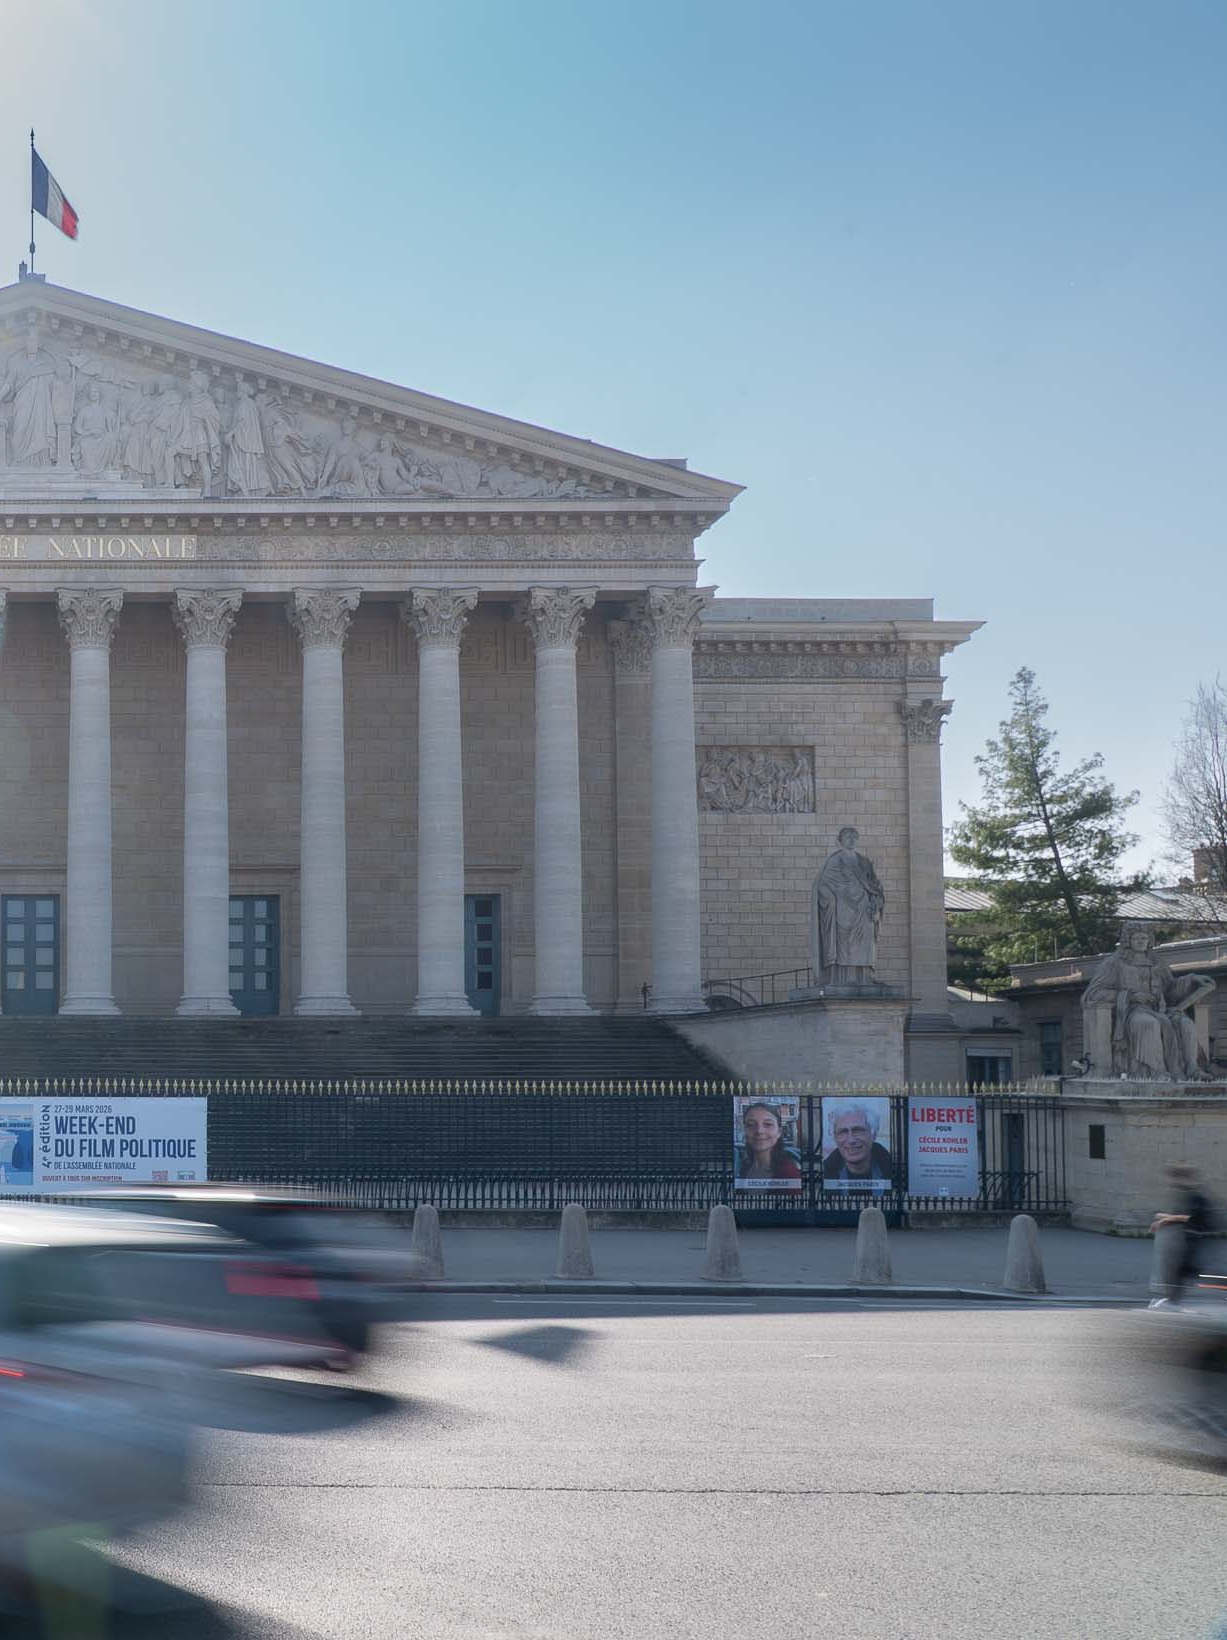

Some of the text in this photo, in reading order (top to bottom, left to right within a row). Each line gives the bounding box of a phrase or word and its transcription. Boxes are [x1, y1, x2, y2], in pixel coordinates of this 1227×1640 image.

[47, 537, 196, 558] NATIONALE
[54, 1105, 113, 1113] 27-29 MARS 2026
[911, 1105, 975, 1124] LIBERTÉ
[55, 1116, 136, 1135] WEEK-END
[55, 1139, 197, 1159] DU FILM POLITIQUE
[54, 1161, 62, 1170] DE
[104, 1161, 137, 1170] NATIONALE
